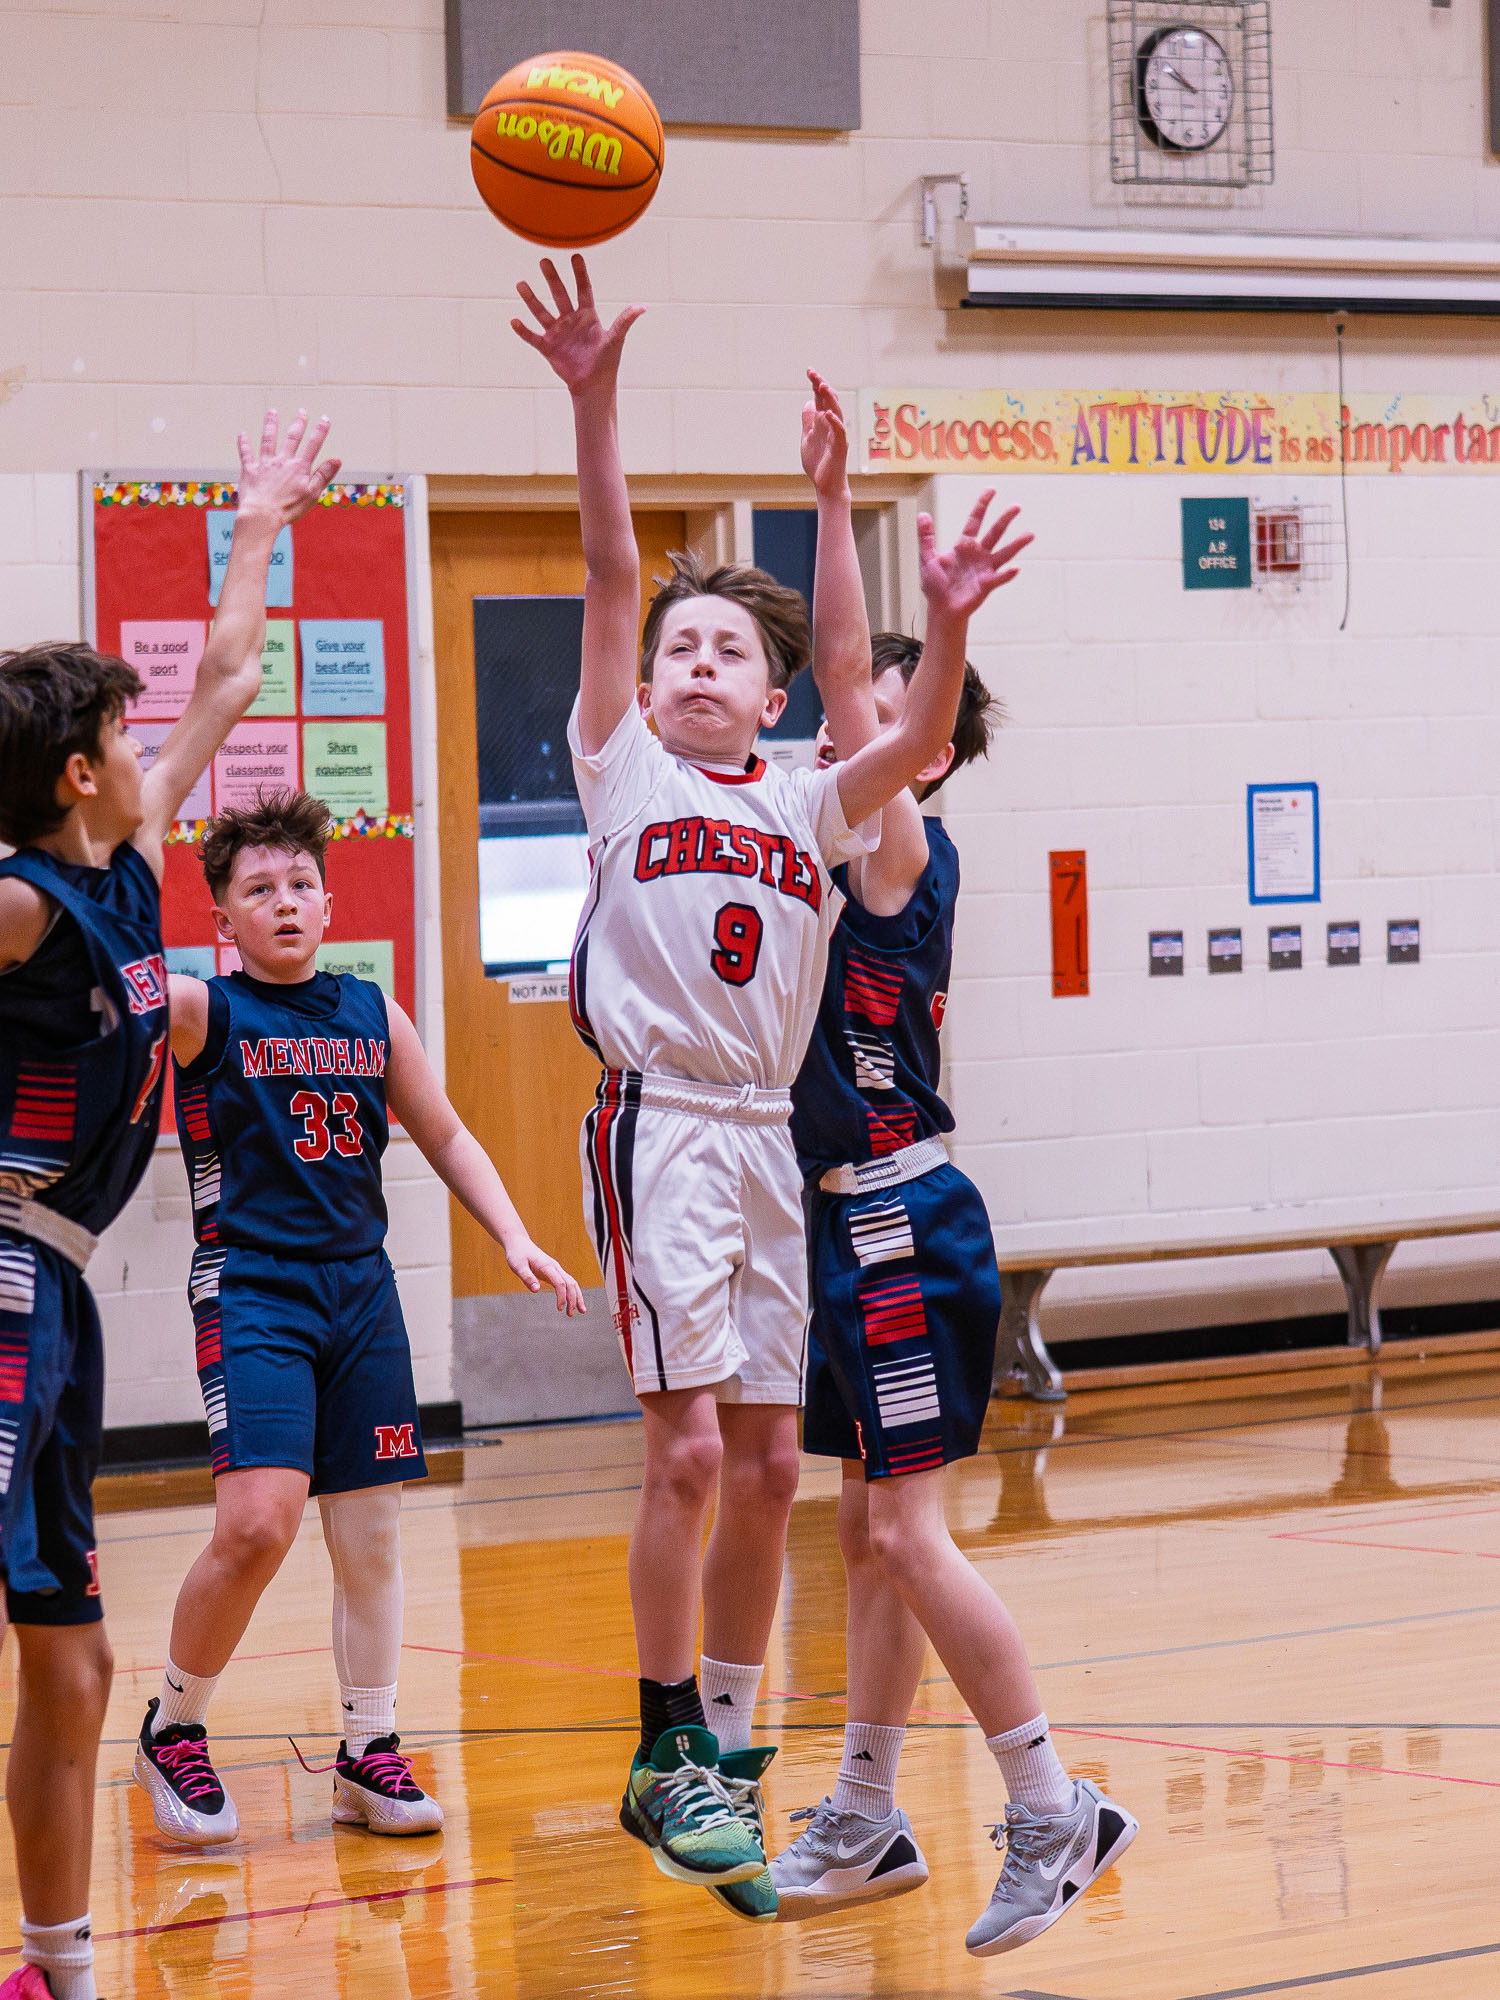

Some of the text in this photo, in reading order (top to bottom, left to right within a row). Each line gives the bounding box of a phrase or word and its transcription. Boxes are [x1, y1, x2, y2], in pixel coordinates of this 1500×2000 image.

[526, 66, 625, 109] NCAA
[496, 111, 623, 176] Wilson
[868, 402, 891, 461] For
[1071, 401, 1275, 466] ATTITUDE
[1279, 426, 1300, 463] is
[1305, 436, 1334, 463] as
[1198, 556, 1237, 570] OFFICE
[135, 641, 188, 654] Be a good
[315, 639, 366, 653] Give your
[149, 663, 178, 676] sport
[315, 661, 371, 675] best effort
[219, 743, 288, 756] Respect your
[327, 742, 358, 754] Share
[225, 764, 285, 777] classmates
[315, 765, 373, 777] equipment
[710, 901, 764, 988] 9
[511, 985, 538, 999] NOT
[541, 985, 558, 997] AN
[239, 1037, 386, 1079] MENDHAM
[290, 1090, 363, 1163] 33
[374, 1422, 419, 1461] M
